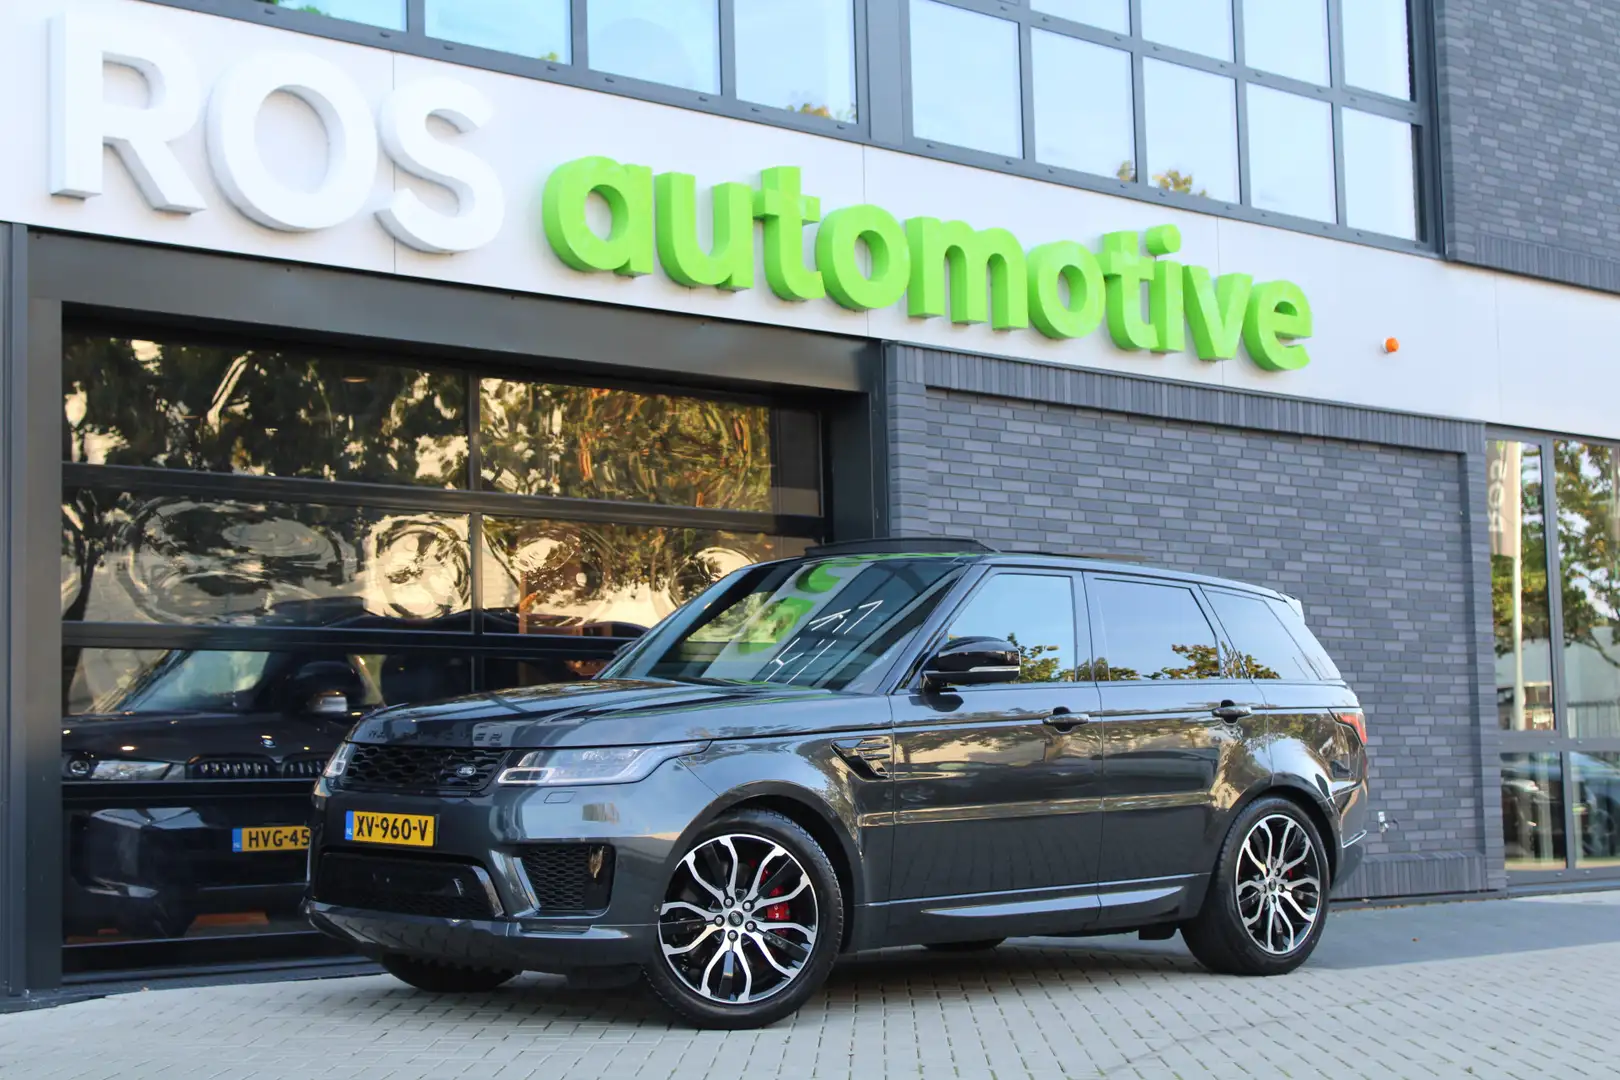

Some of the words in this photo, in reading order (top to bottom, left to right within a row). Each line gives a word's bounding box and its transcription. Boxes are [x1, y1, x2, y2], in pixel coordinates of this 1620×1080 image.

[49, 12, 506, 253] ROS
[542, 155, 1312, 371] automotive
[356, 815, 429, 842] XV-960-V
